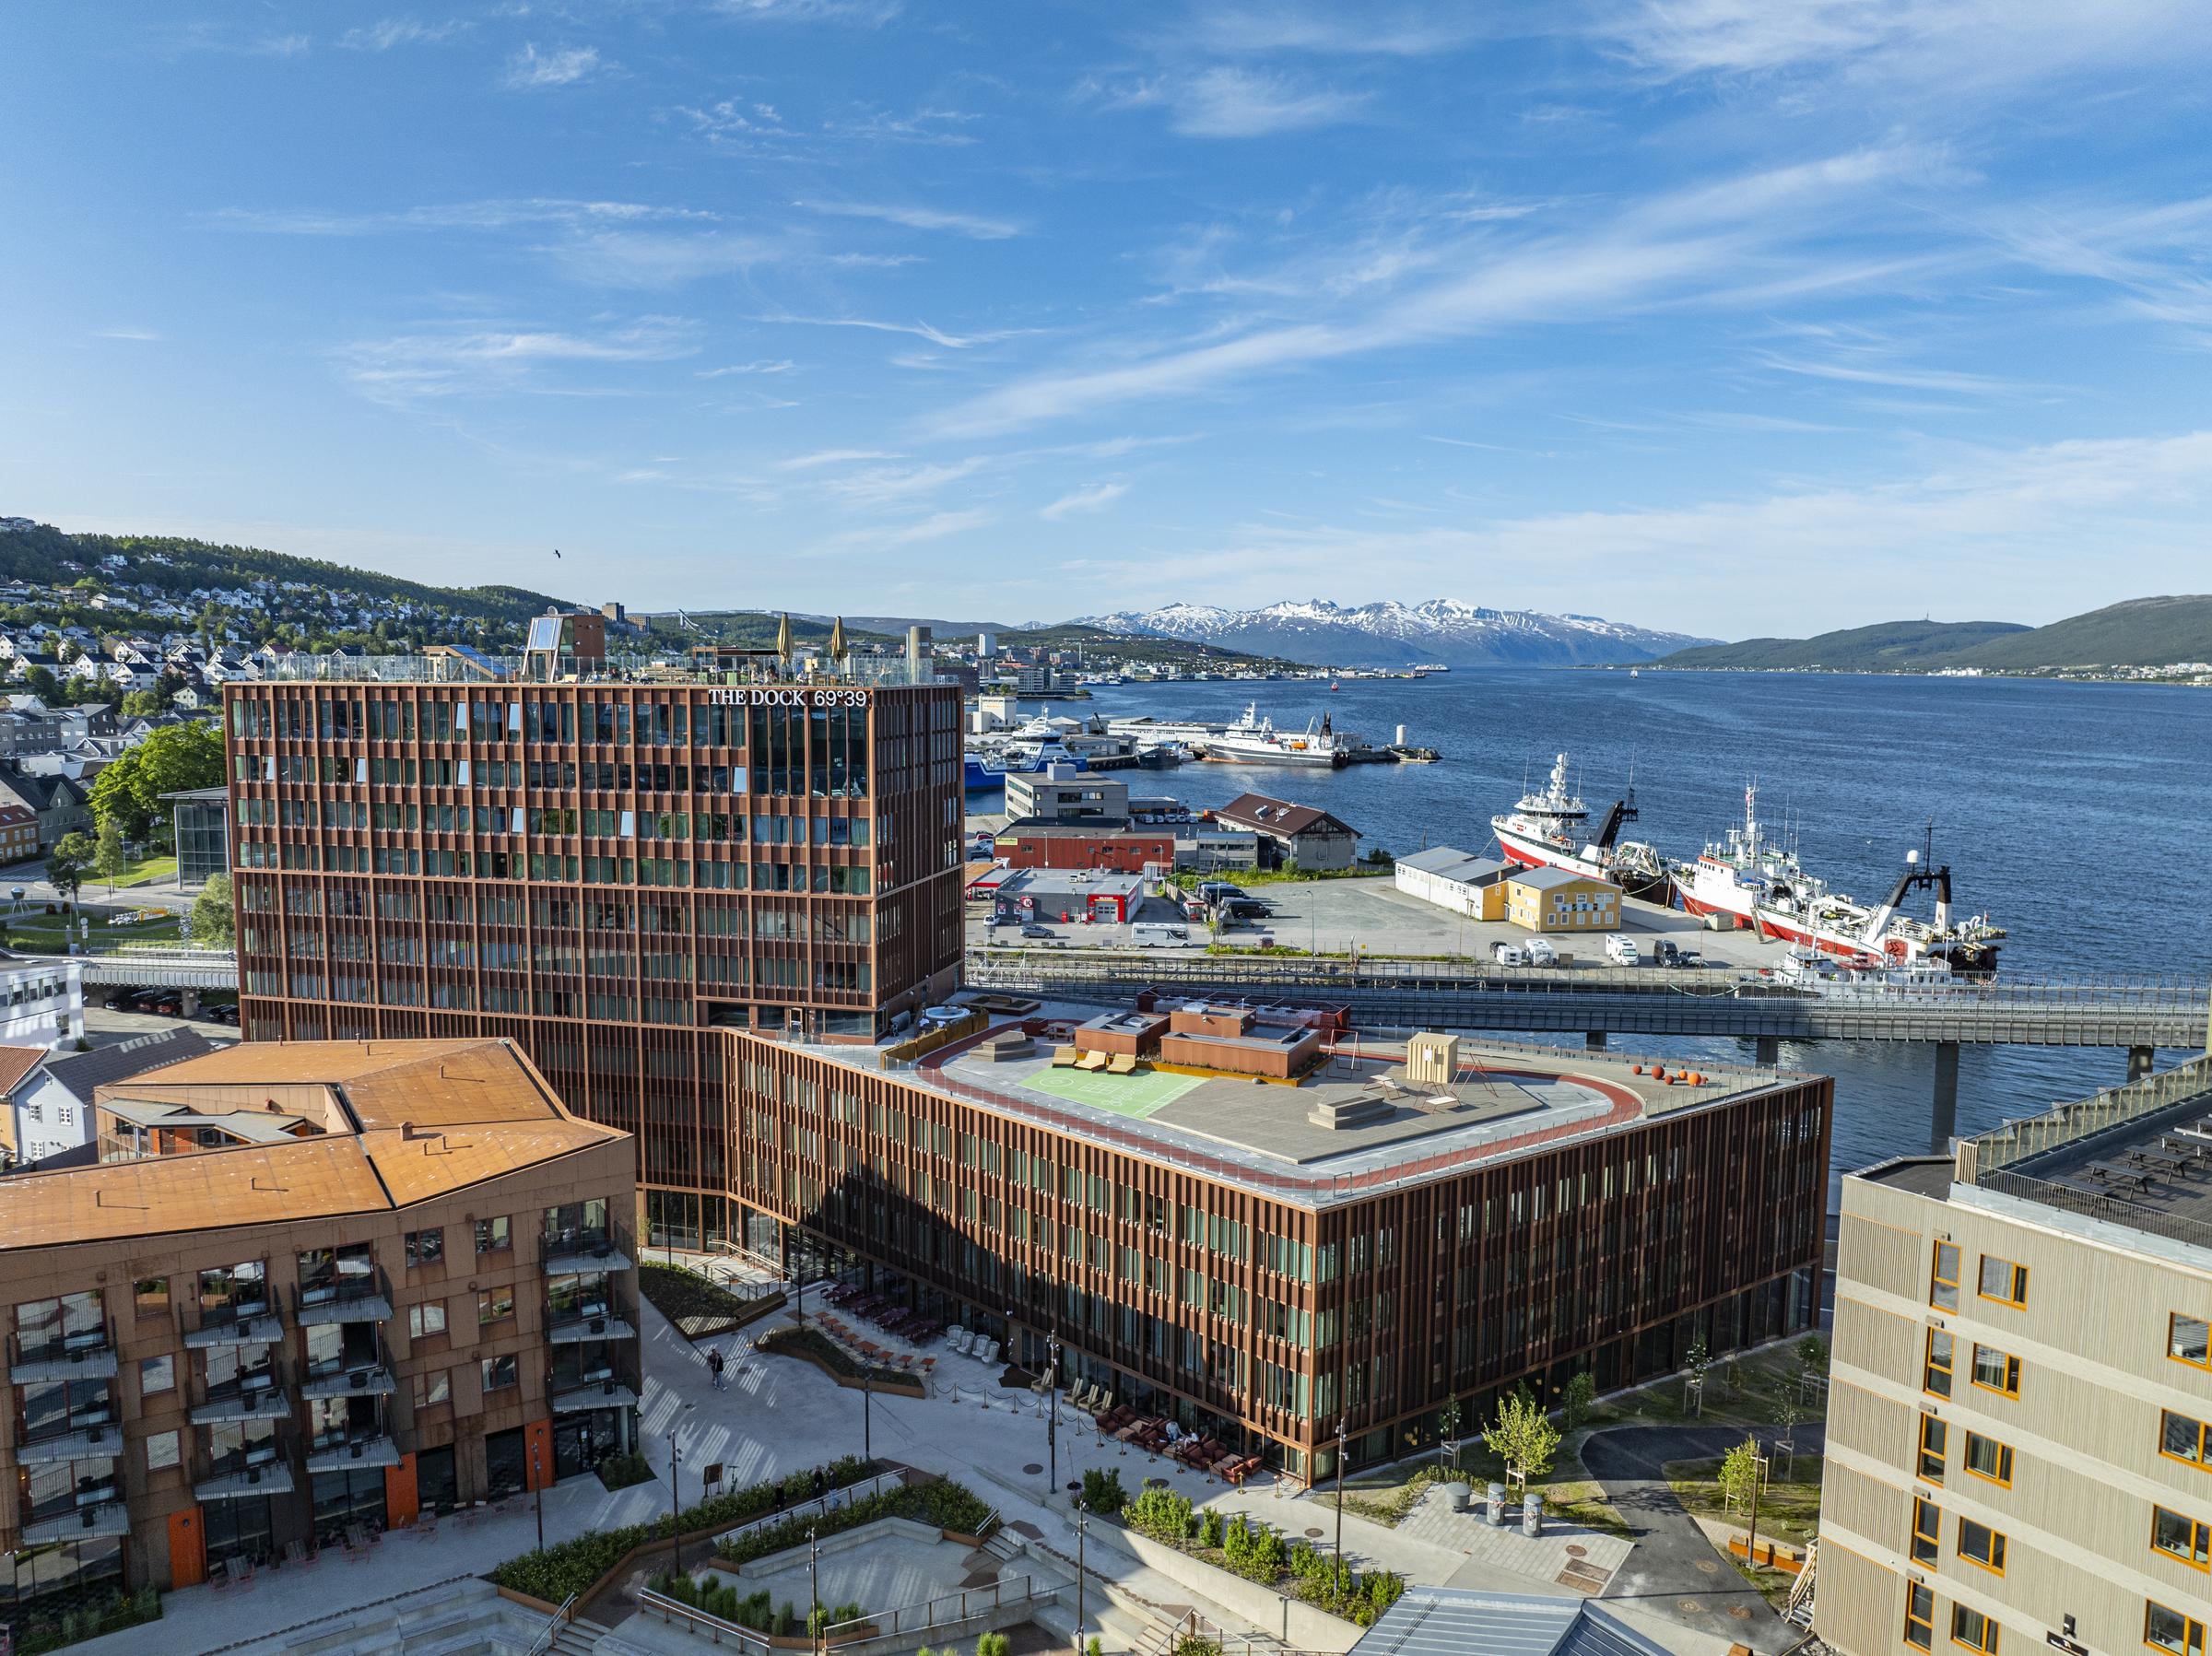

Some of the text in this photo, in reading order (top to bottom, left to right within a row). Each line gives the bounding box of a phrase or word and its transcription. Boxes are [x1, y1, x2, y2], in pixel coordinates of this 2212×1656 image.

[709, 689, 866, 707] THE DOCK 69°39
